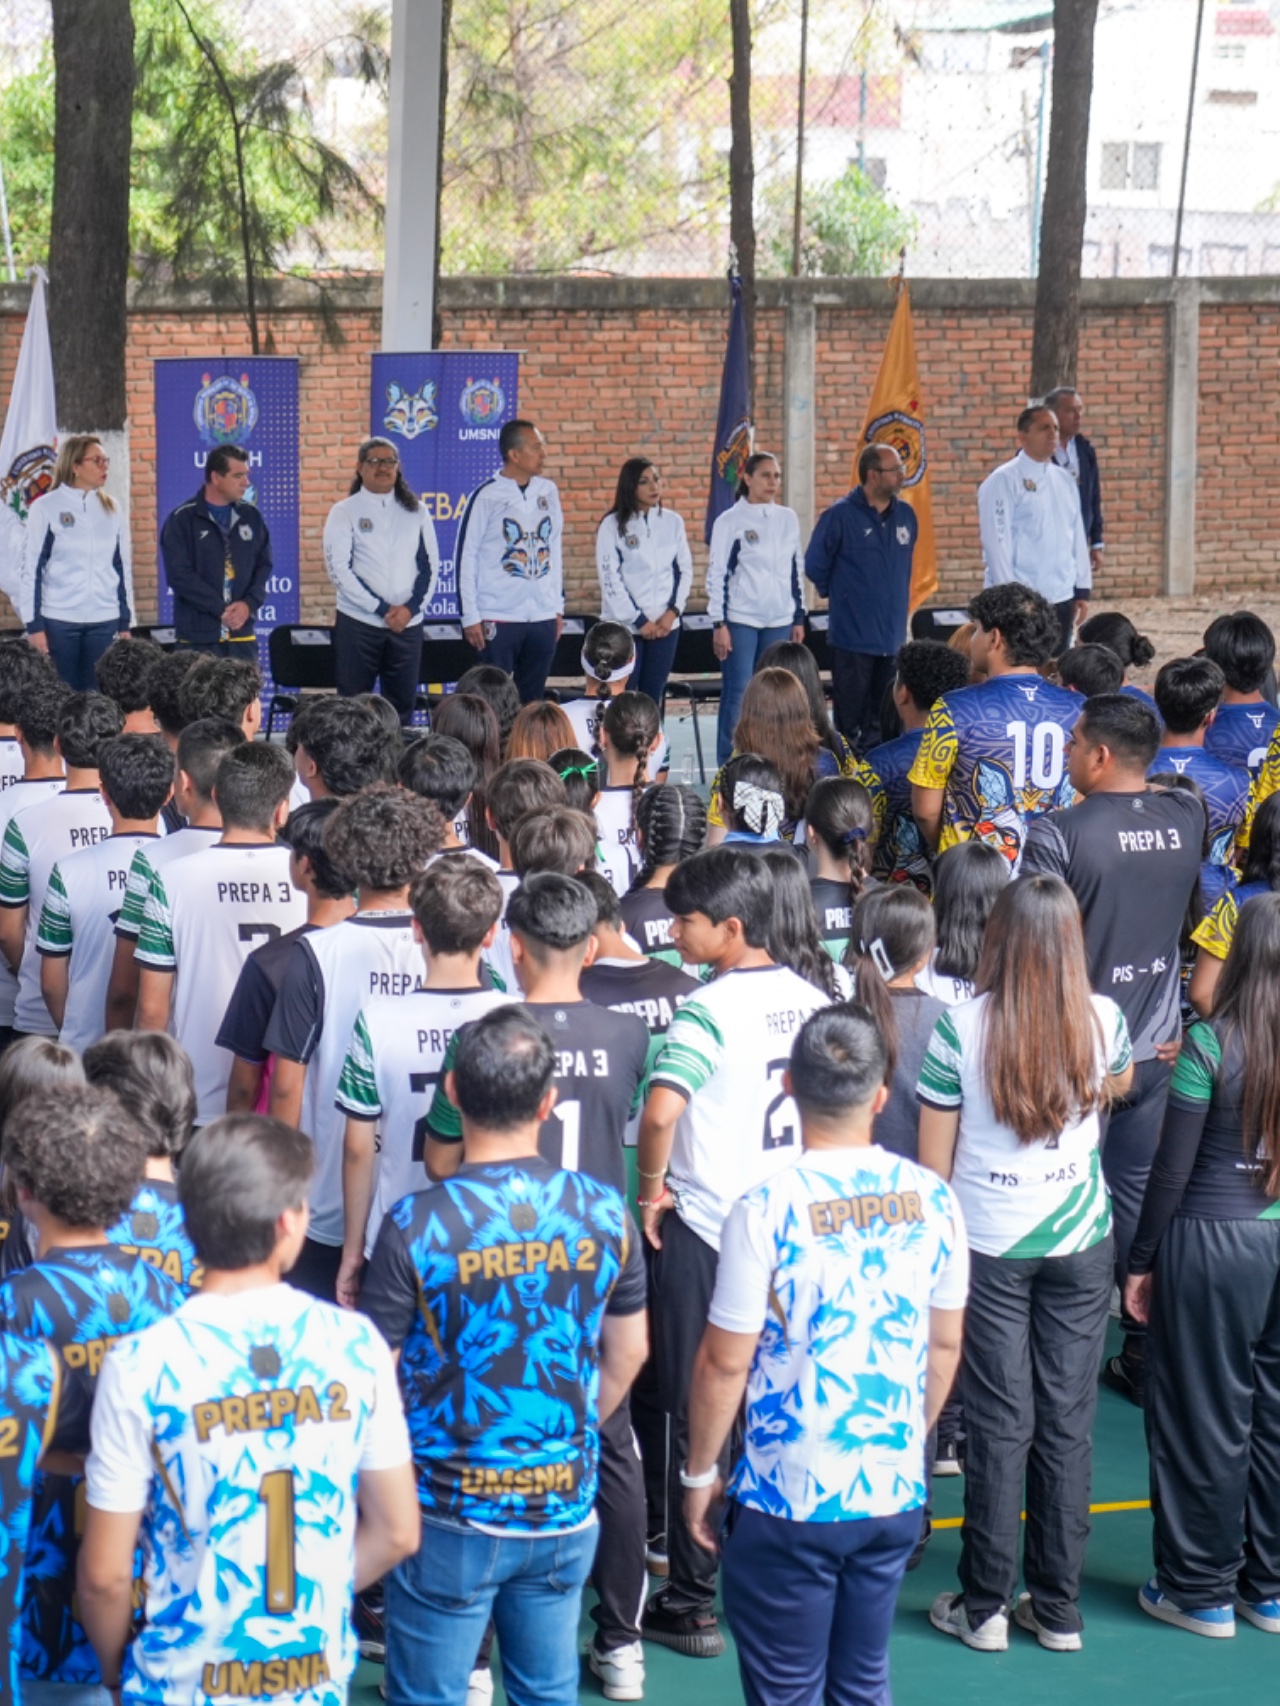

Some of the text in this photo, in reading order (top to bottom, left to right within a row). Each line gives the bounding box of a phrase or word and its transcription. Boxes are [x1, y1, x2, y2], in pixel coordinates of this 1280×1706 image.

[1006, 720, 1066, 790] 10
[1118, 828, 1181, 852] PREPA 3
[217, 882, 290, 903] PREPA 3
[1112, 964, 1133, 983] PIS
[591, 1050, 609, 1077] 3
[808, 1191, 924, 1237] EPIPOR
[458, 1238, 597, 1285] PREPA 2
[192, 1380, 353, 1441] PREPA 2
[460, 1463, 573, 1496] UMSNH
[259, 1468, 296, 1615] 1
[200, 1653, 331, 1699] UMSNH
